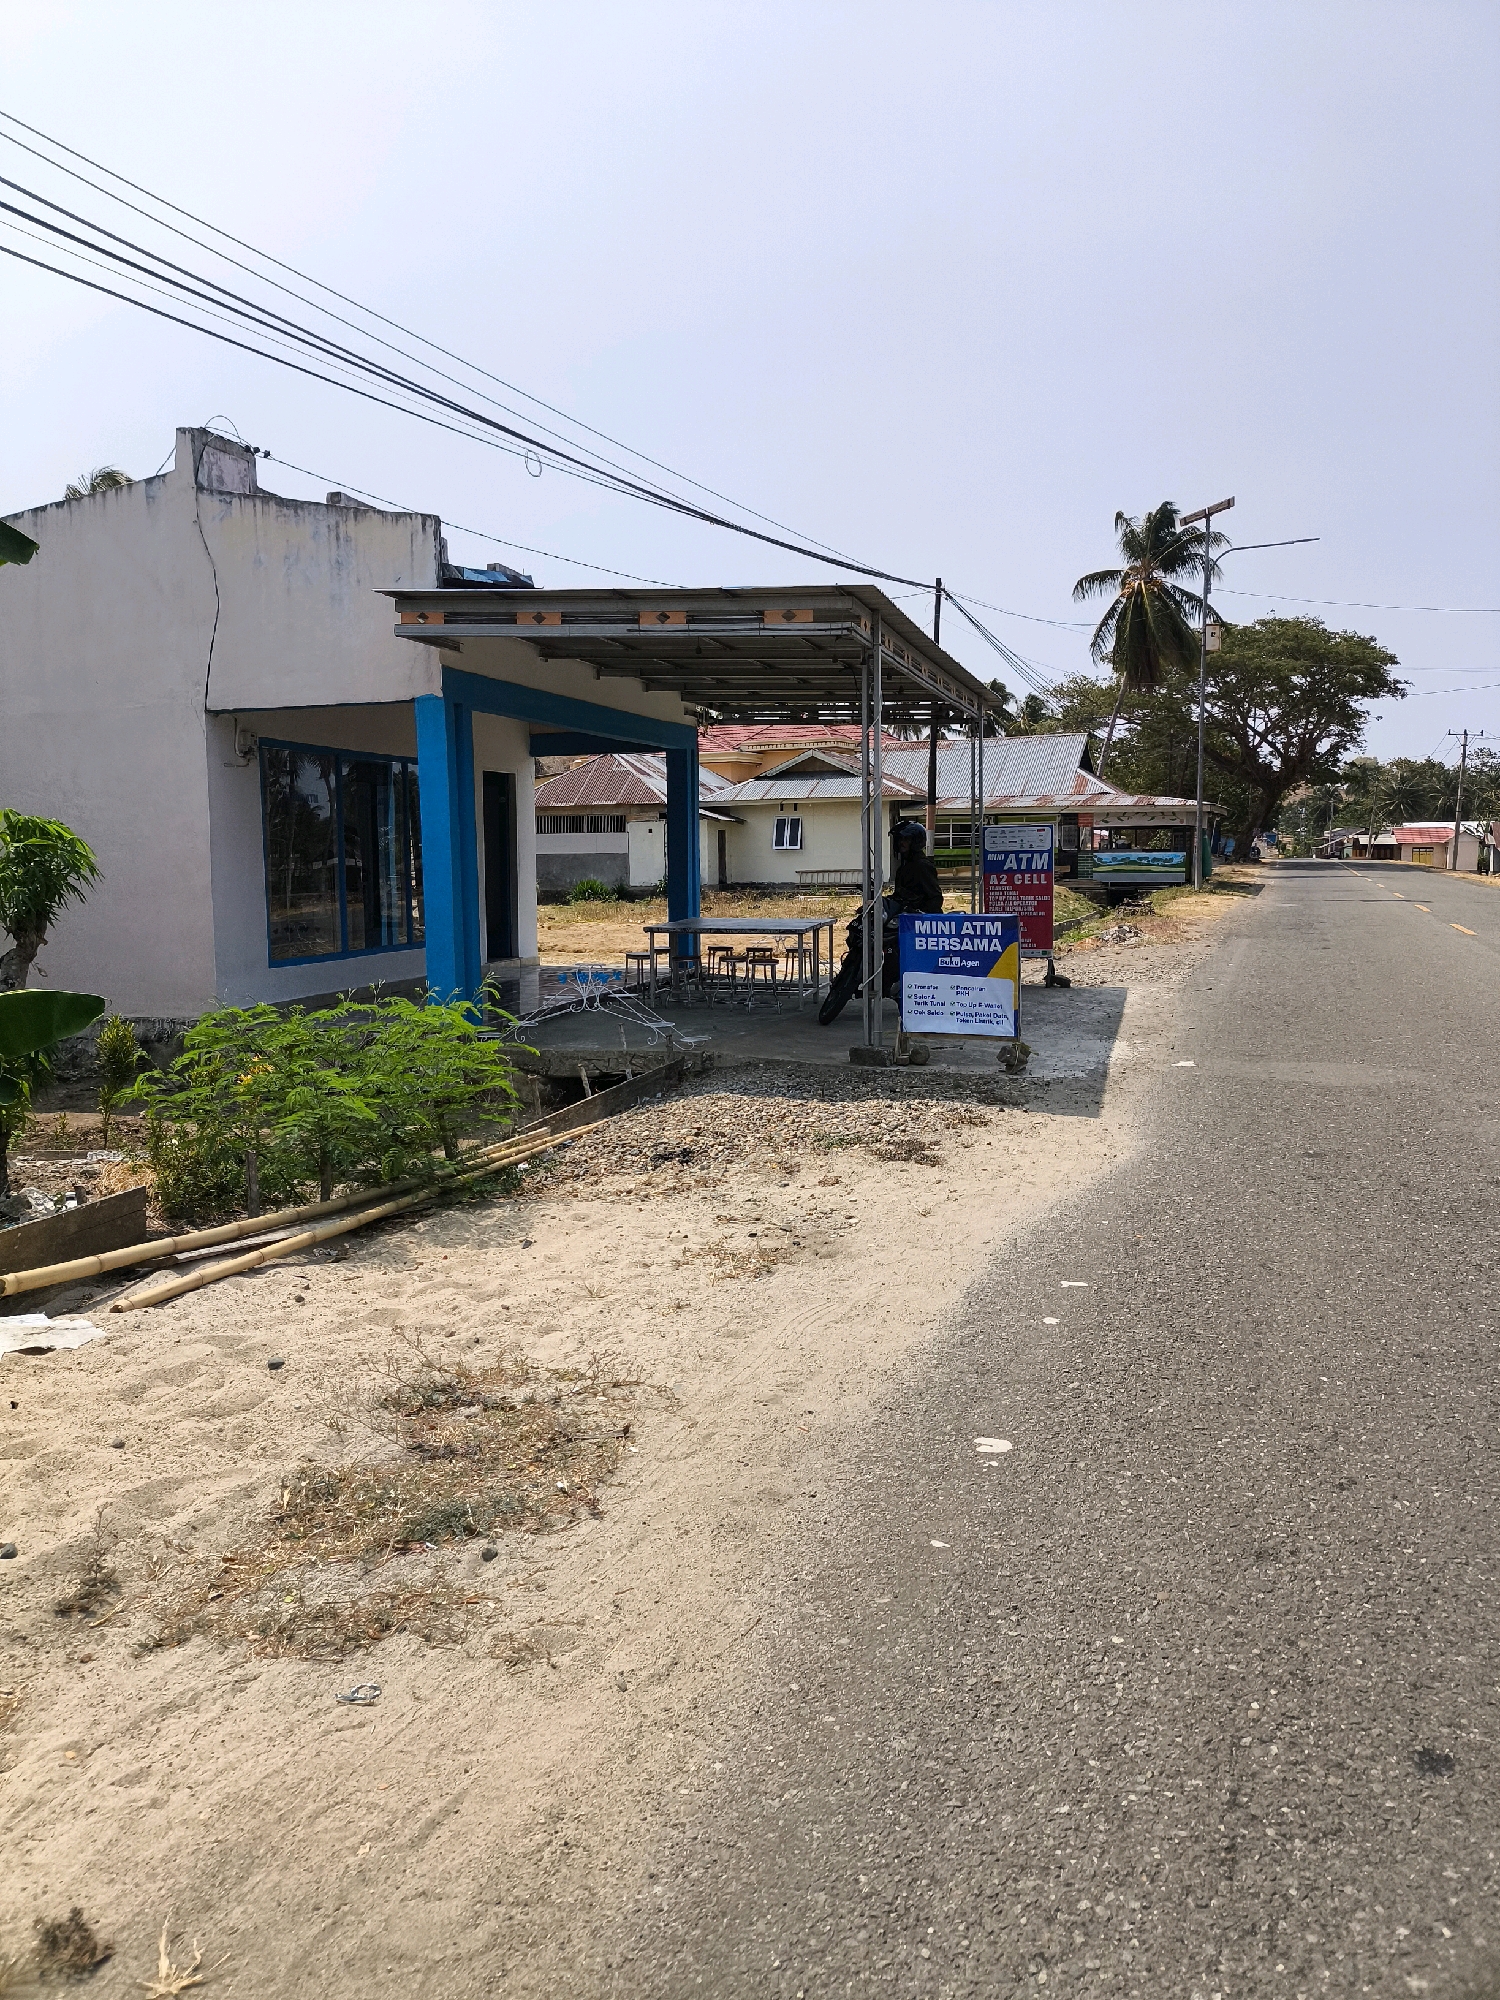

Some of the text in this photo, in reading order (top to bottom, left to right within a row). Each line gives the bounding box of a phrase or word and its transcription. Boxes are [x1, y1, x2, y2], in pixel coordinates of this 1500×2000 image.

[1003, 852, 1049, 870] ATM
[989, 873, 1047, 885] A2 CELL
[914, 920, 1002, 936] MINI ATM
[915, 937, 1003, 952] BERSAMA
[960, 959, 980, 968] Agen
